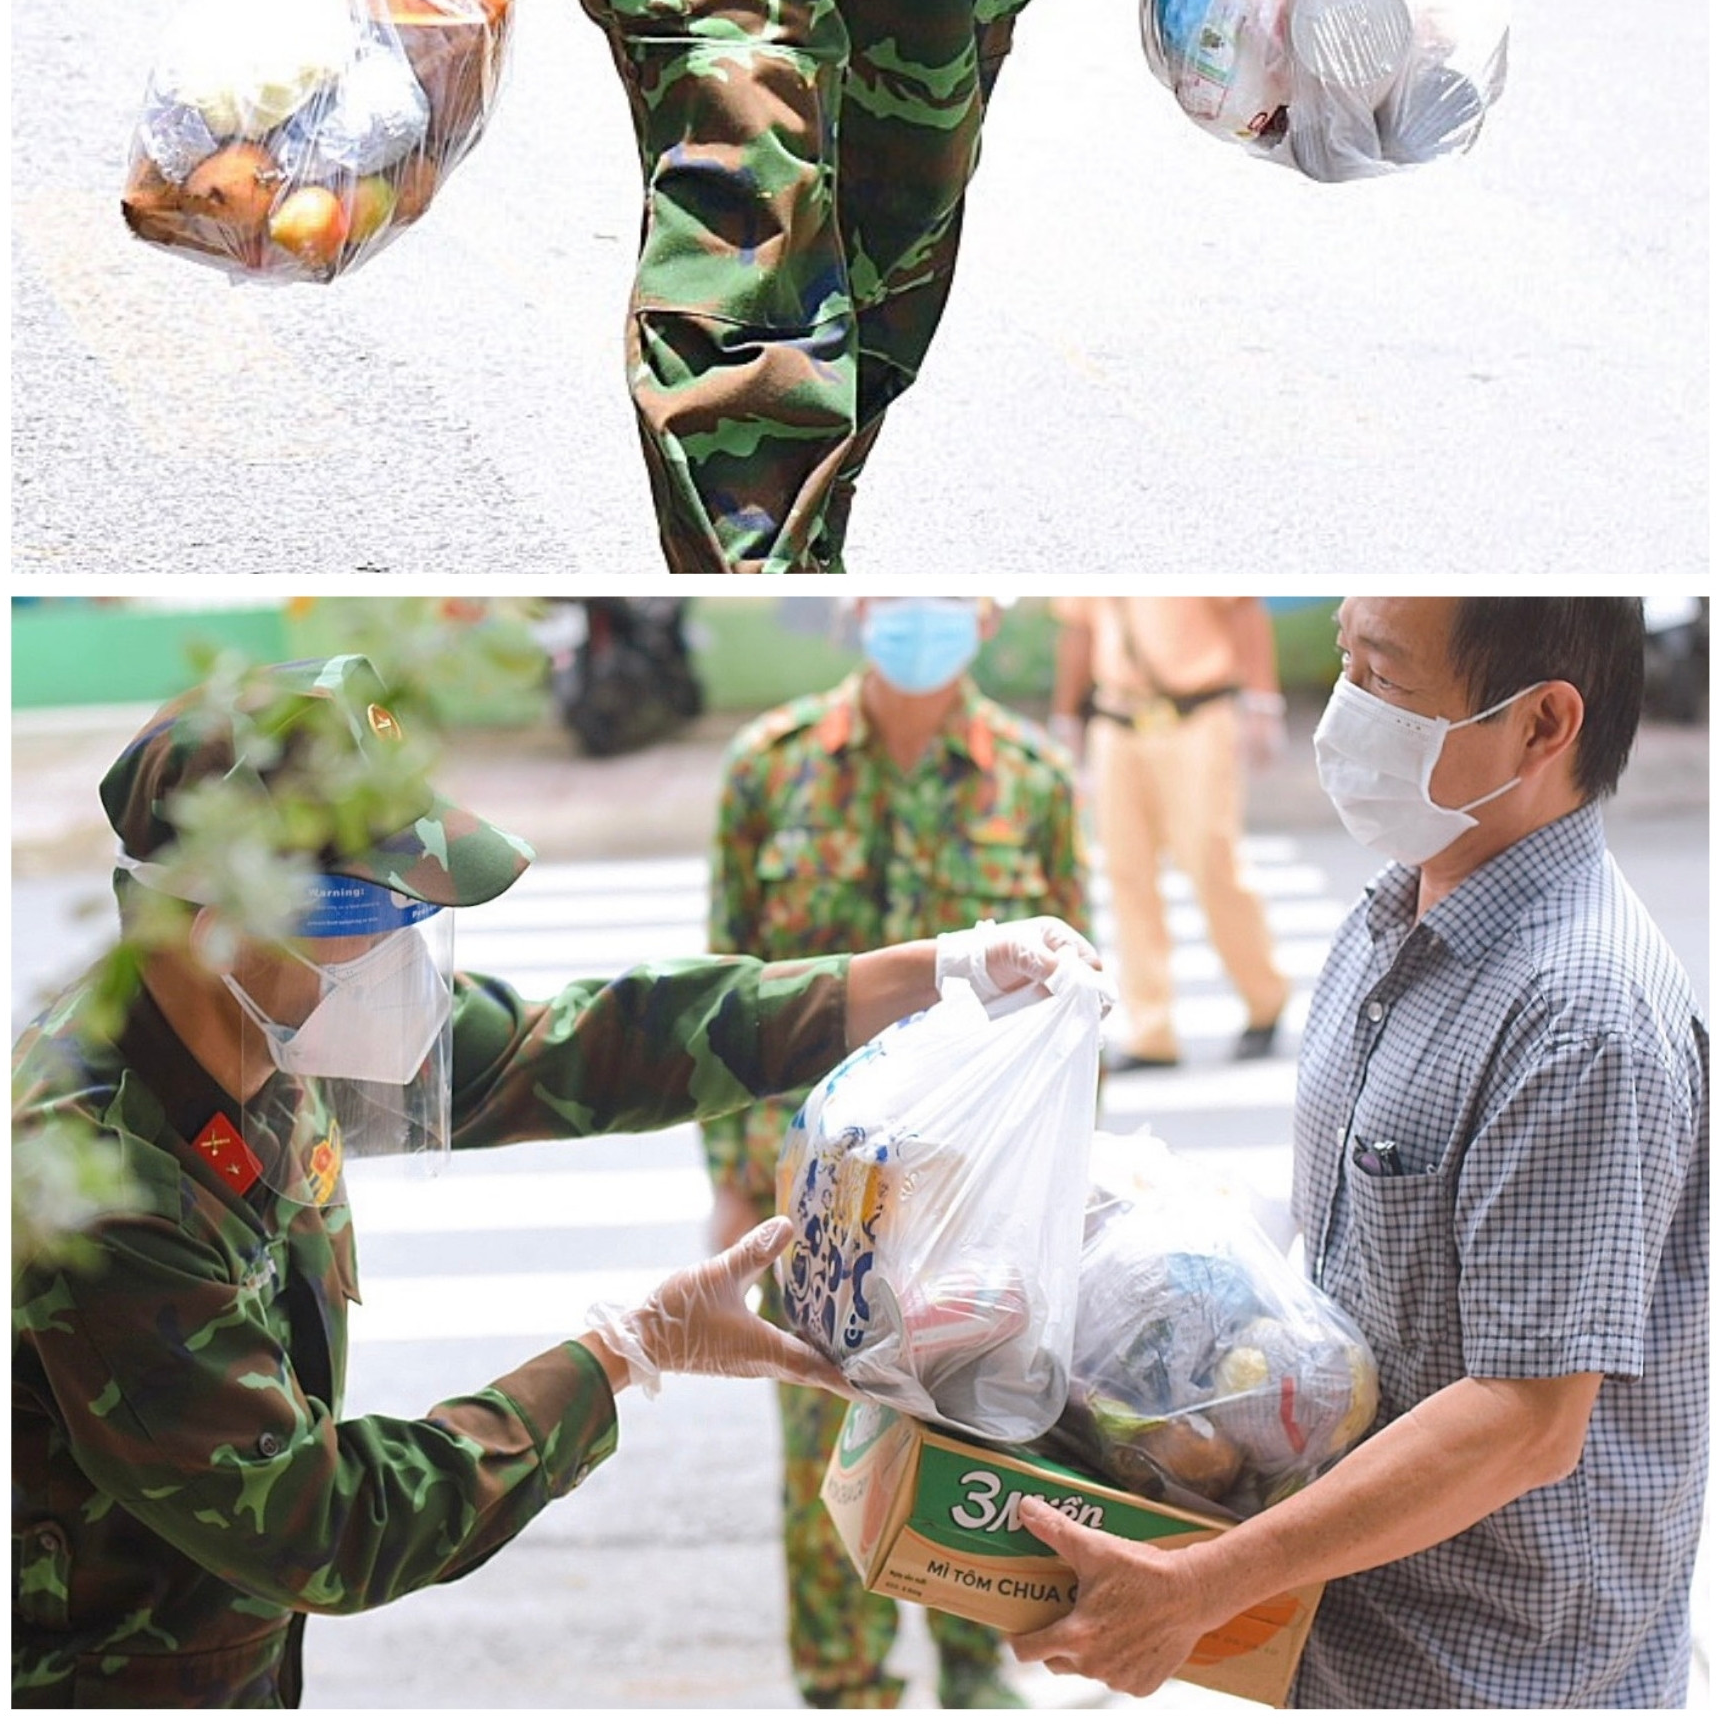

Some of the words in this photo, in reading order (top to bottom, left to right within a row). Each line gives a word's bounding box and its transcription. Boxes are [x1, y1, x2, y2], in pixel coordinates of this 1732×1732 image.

[927, 1559, 950, 1579] MÌ
[954, 1569, 992, 1592] TÔM
[997, 1578, 1061, 1603] CHUA
